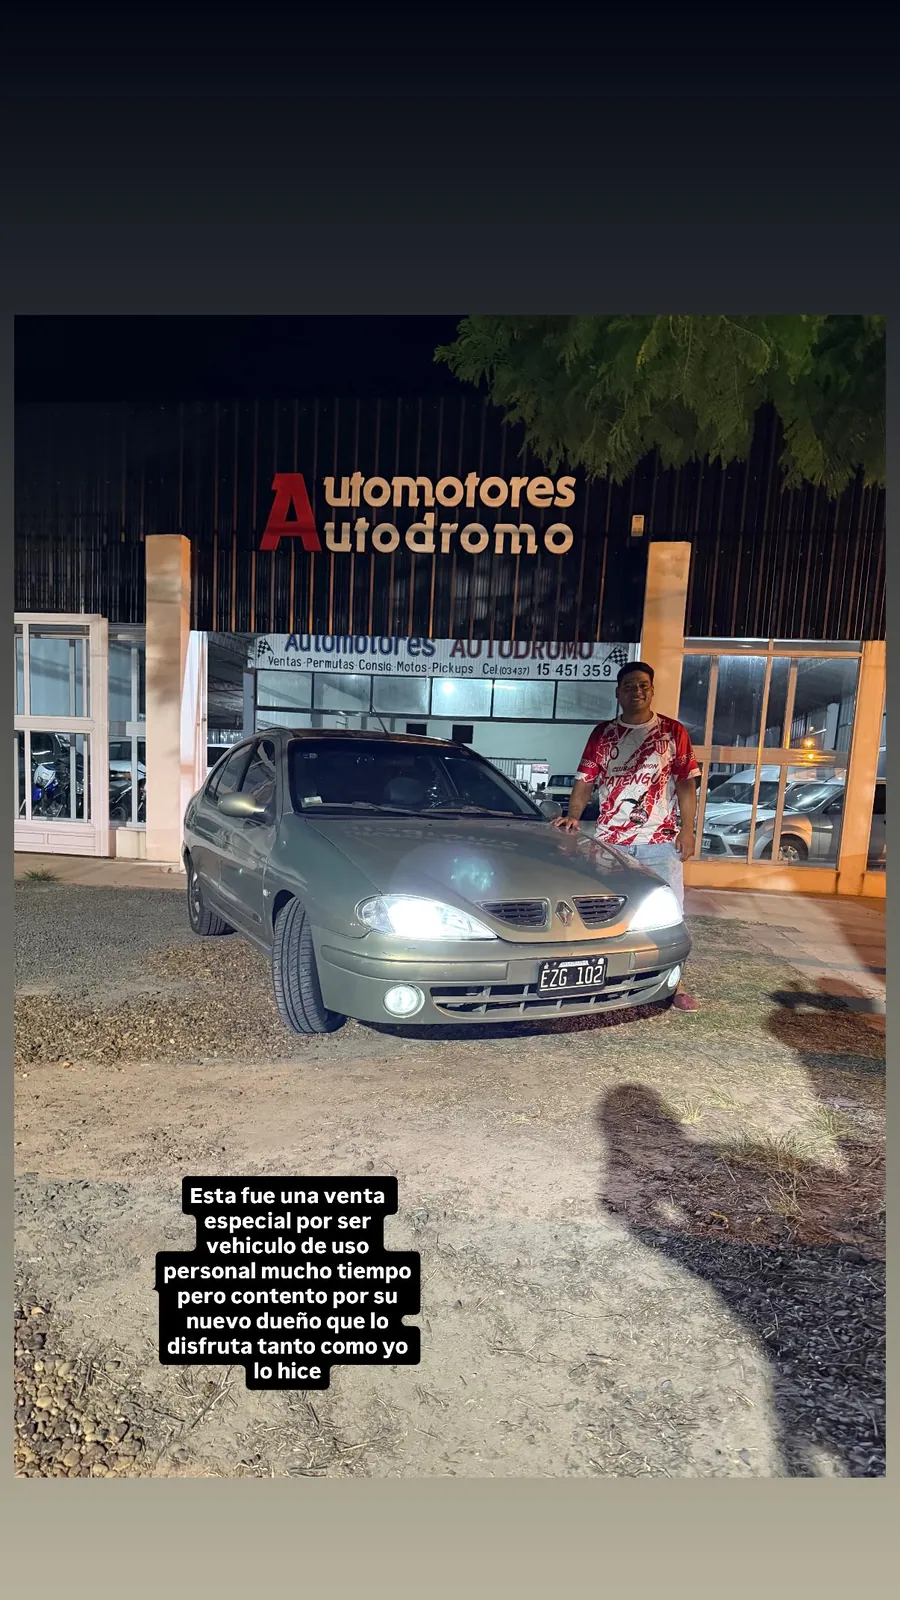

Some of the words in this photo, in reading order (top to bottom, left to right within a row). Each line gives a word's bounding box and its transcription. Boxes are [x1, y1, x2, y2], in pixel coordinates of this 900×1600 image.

[268, 656, 302, 667] Ventas
[306, 657, 354, 670] Permutas
[396, 661, 427, 673] Motos
[432, 662, 474, 675] Pickups
[536, 663, 550, 676] 15
[555, 664, 577, 677] 451
[582, 664, 612, 677] 359
[540, 968, 568, 988] EZG
[575, 965, 603, 985] 102
